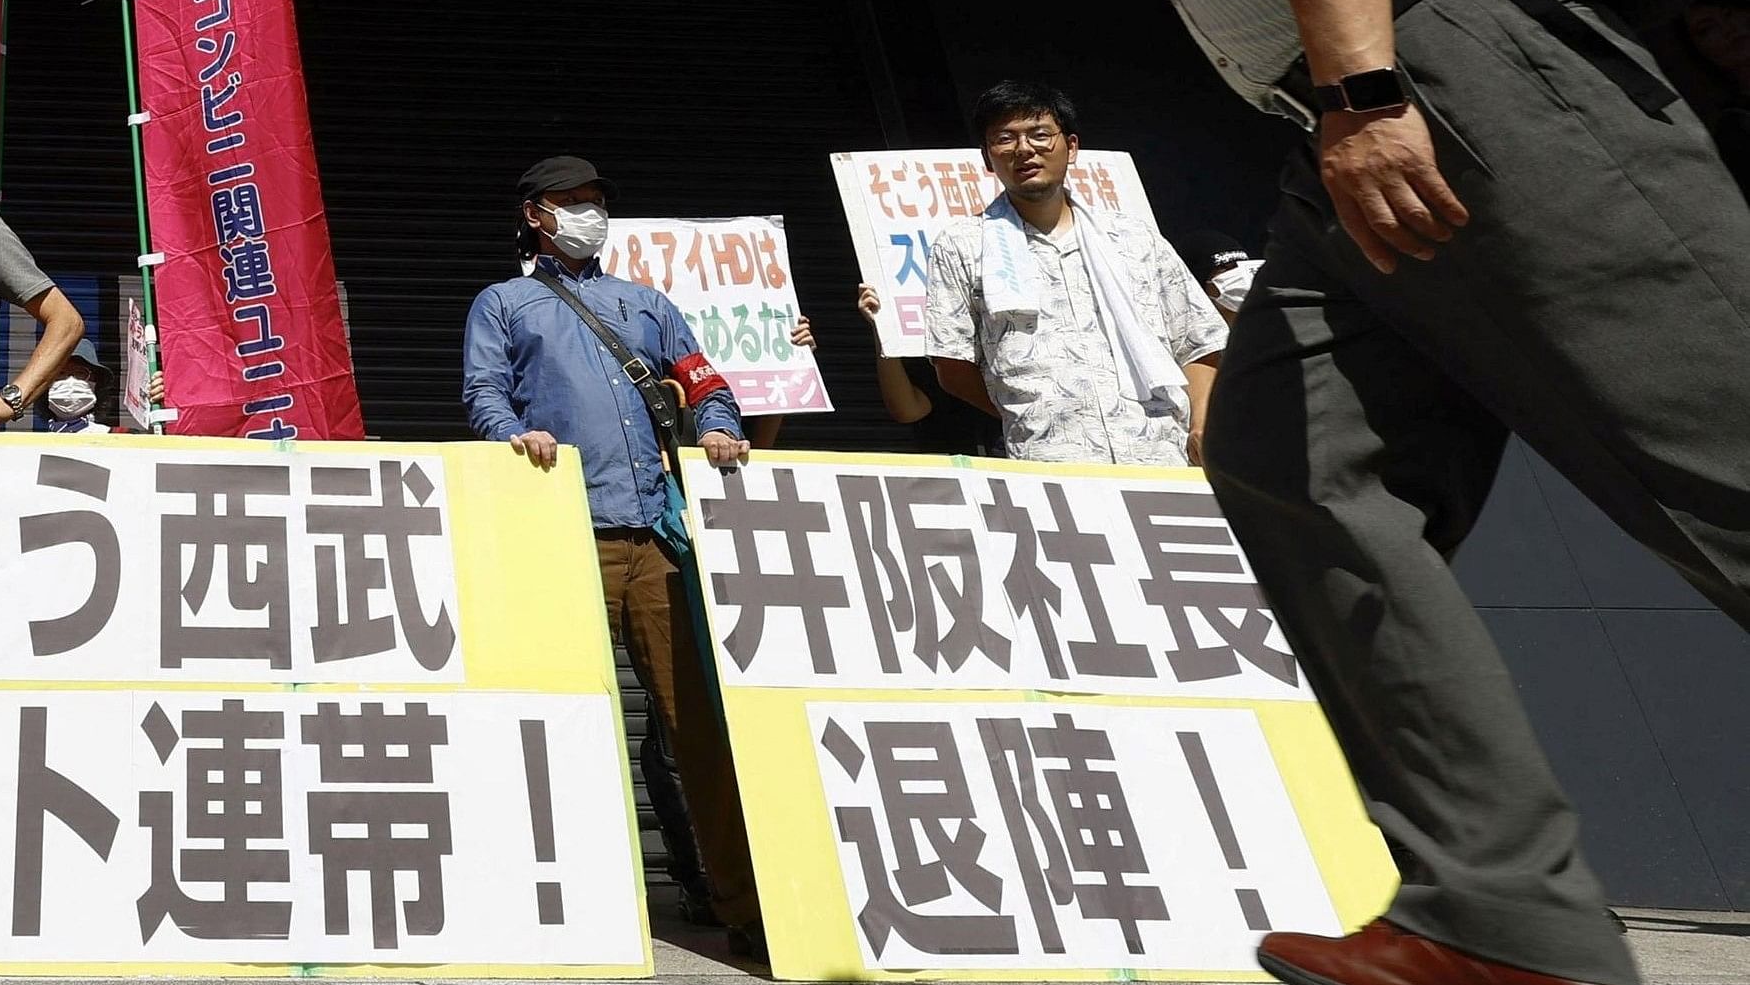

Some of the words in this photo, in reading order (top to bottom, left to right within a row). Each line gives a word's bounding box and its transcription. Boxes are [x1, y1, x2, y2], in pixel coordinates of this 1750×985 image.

[606, 228, 787, 294] &アイHDは
[700, 467, 1299, 689] 井阪社長
[820, 713, 1272, 962] 退陣！
